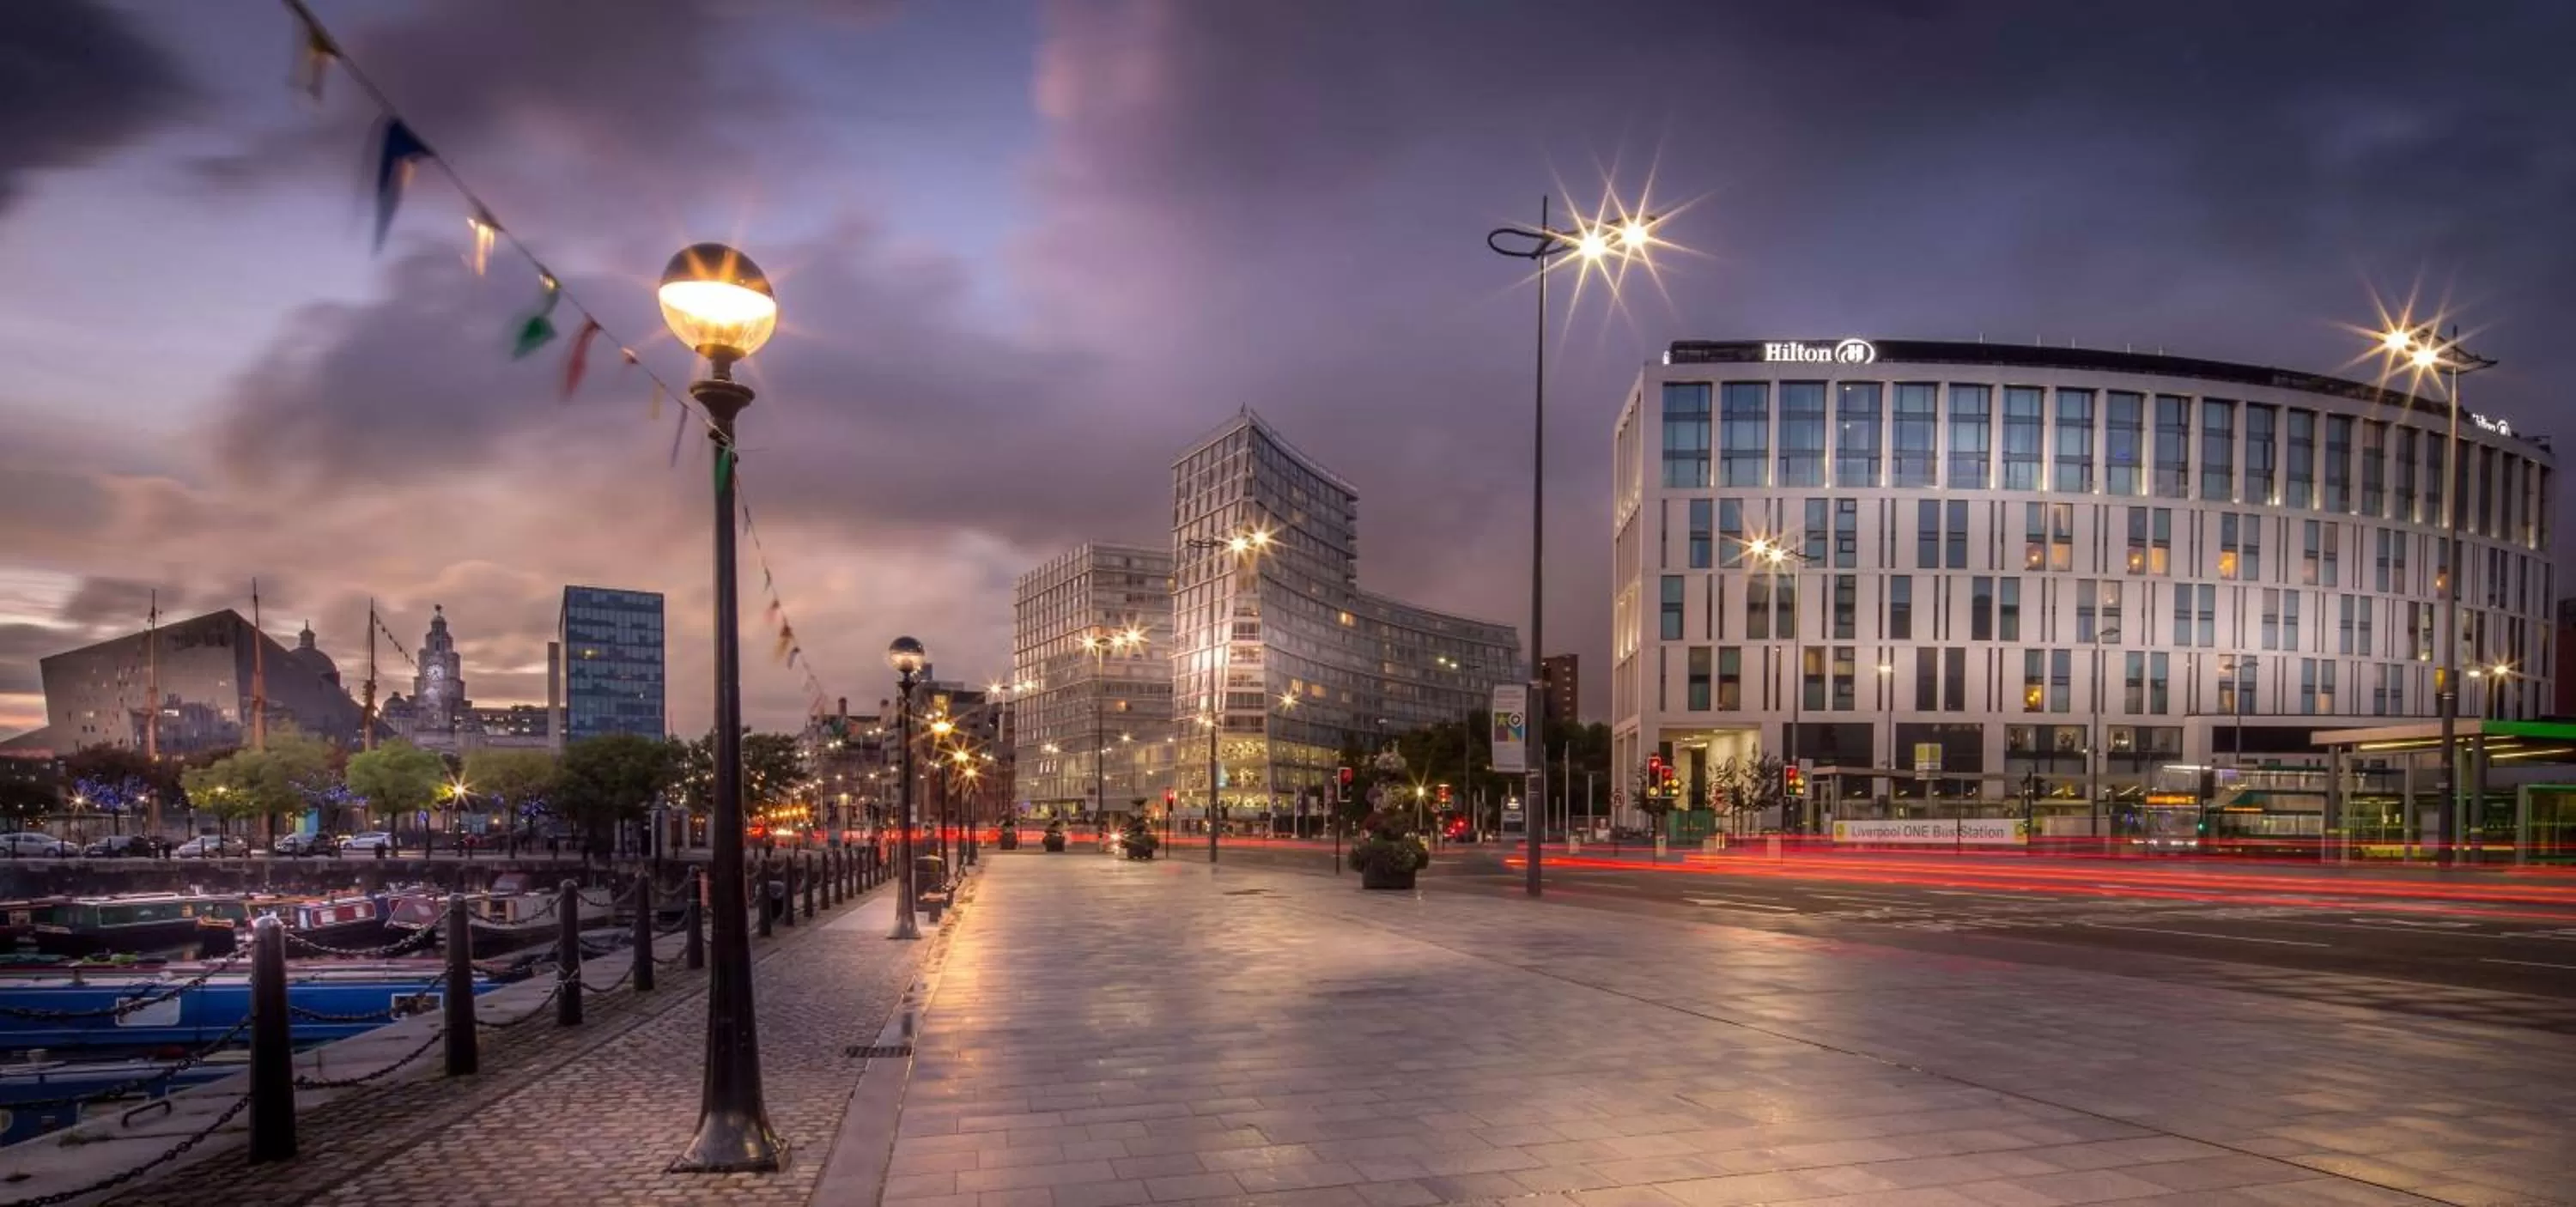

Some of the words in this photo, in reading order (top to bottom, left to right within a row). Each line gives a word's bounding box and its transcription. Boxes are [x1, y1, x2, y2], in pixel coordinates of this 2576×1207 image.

[1765, 342, 1832, 361] Hilton
[1850, 825, 1900, 840] Liverpool
[1904, 825, 1929, 839] ONE
[1933, 824, 1958, 839] Bus
[1959, 824, 2005, 839] Station
